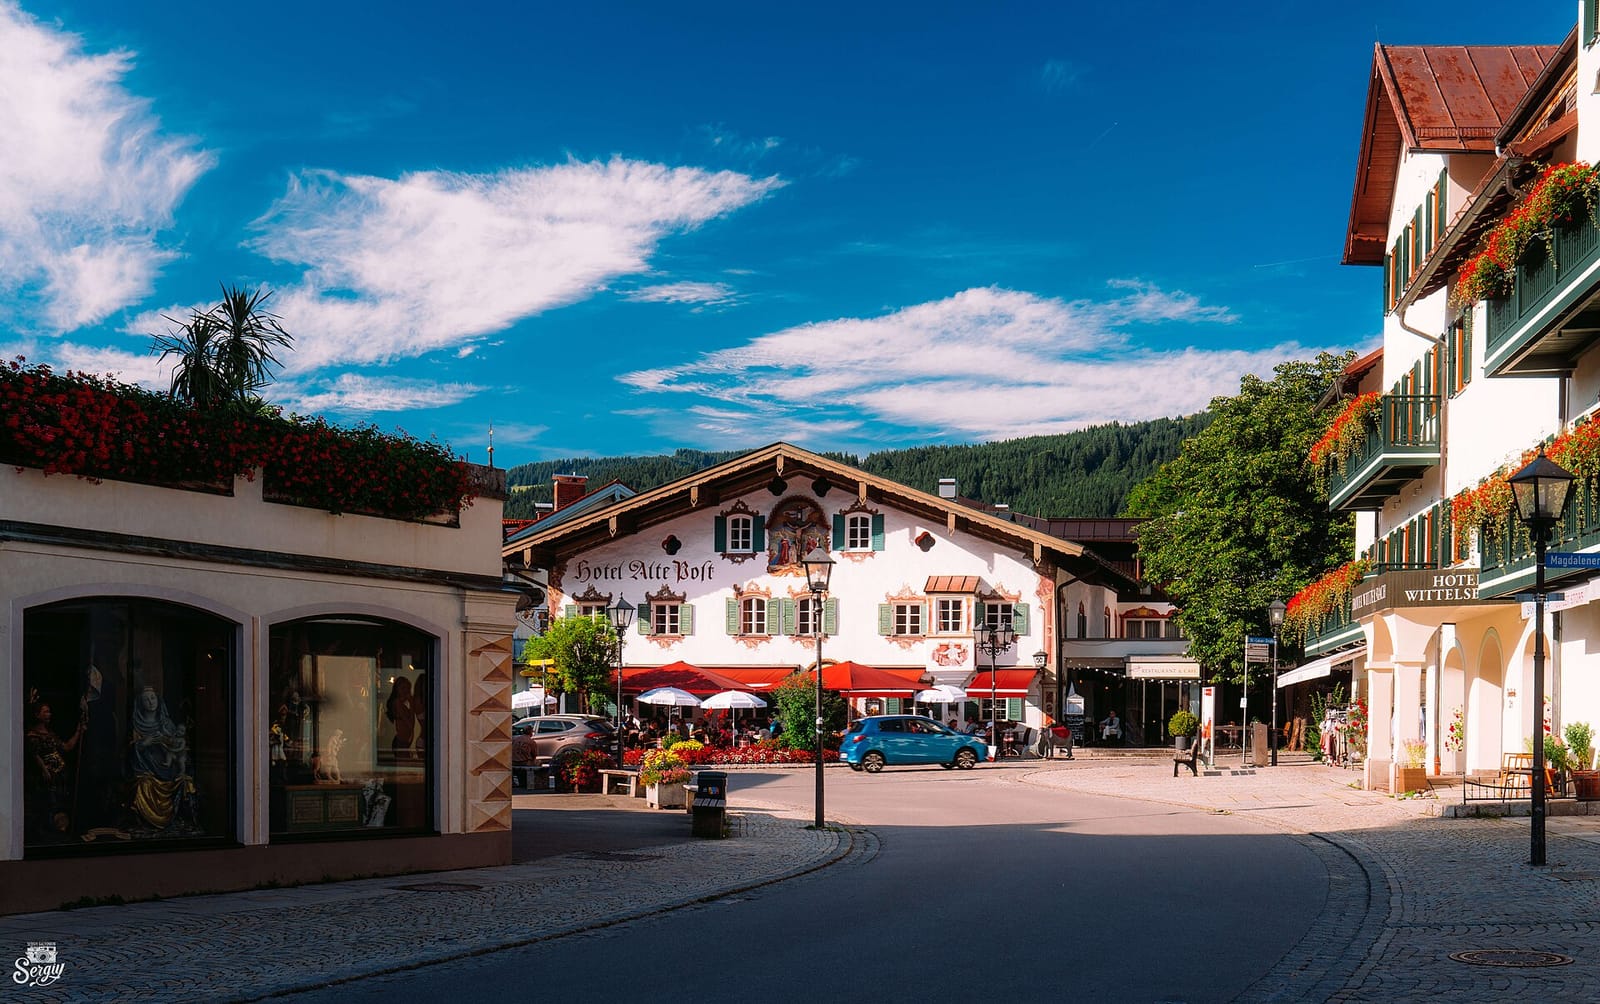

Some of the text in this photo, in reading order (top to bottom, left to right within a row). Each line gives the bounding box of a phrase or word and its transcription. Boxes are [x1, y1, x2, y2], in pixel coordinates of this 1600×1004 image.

[574, 559, 623, 583] Hotel
[628, 559, 670, 580] Alte
[1405, 588, 1480, 602] WITTELSB
